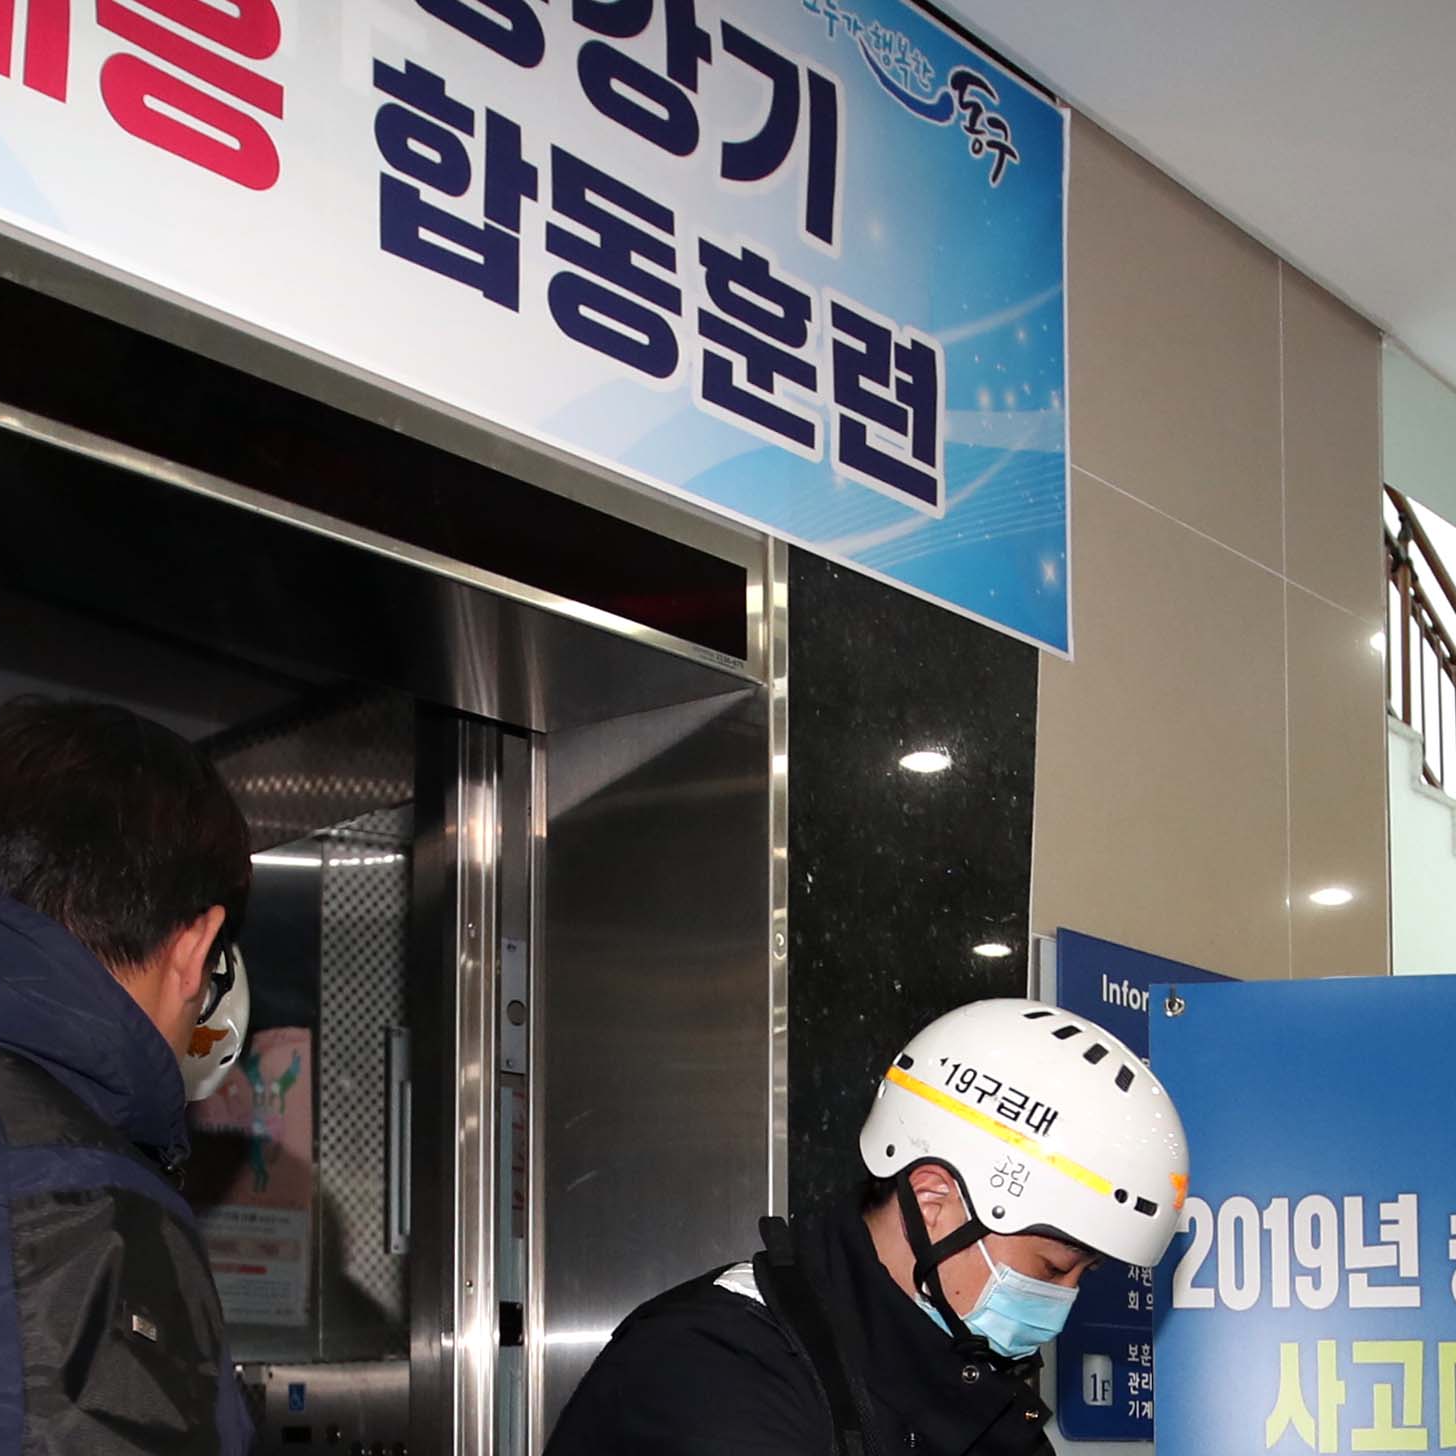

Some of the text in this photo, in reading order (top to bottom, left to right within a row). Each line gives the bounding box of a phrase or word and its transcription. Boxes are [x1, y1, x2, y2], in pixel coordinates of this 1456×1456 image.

[867, 20, 936, 91] 행복한
[949, 68, 1020, 187] 동구
[372, 57, 939, 508] 합동훈련
[940, 1057, 1059, 1137] 19구급대
[1173, 1193, 1422, 1310] 2019년
[1089, 1373, 1111, 1403] 1F
[1127, 1343, 1152, 1367] 보훈
[1127, 1372, 1153, 1395] 관리
